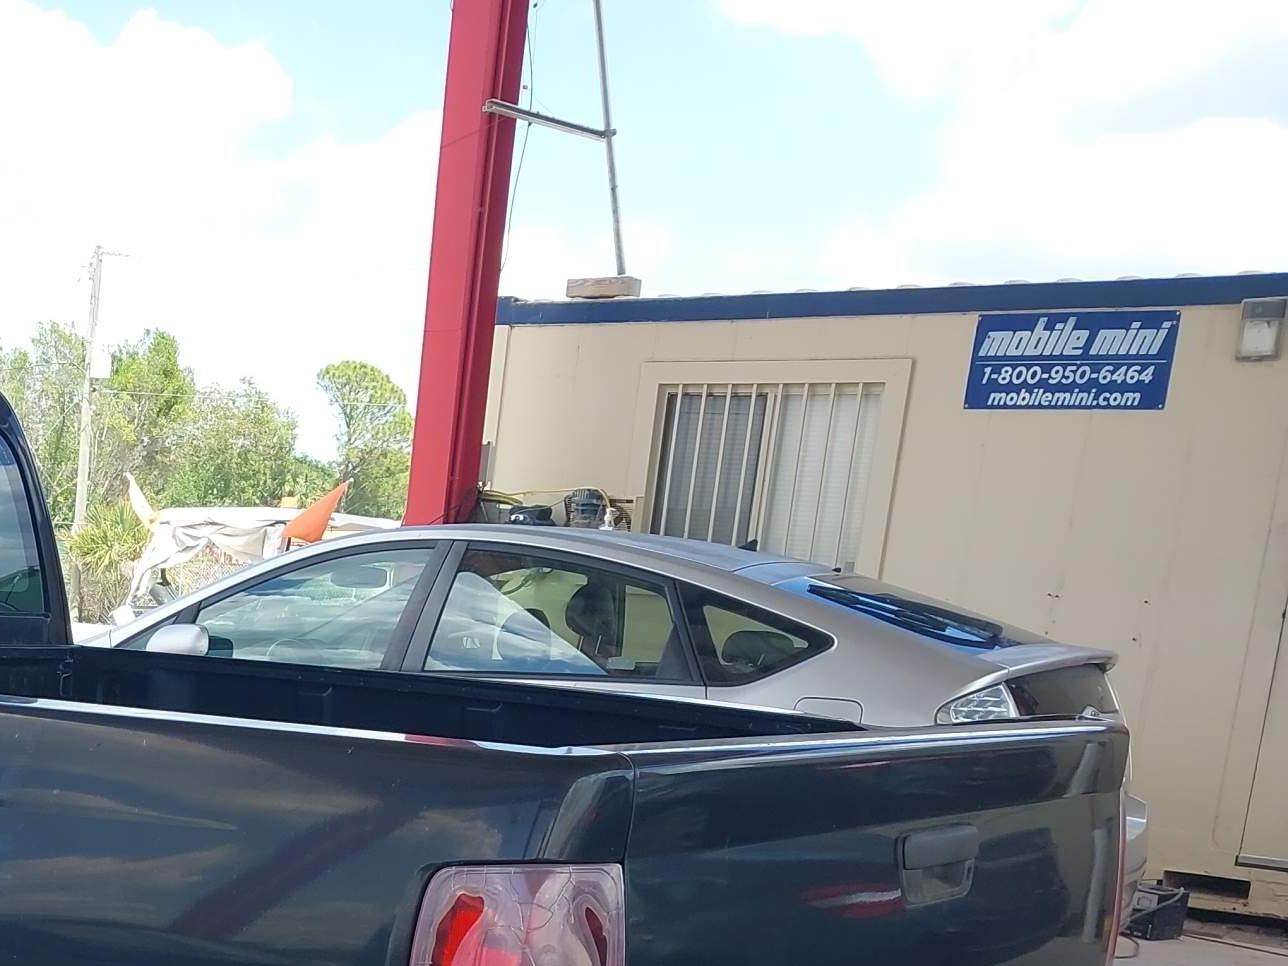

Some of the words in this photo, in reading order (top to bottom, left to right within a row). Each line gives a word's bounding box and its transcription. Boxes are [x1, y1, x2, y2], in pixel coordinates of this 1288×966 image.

[978, 317, 1090, 356] mobile
[1089, 321, 1172, 355] mini
[982, 365, 1156, 385] 1-800-950-6464
[987, 389, 1141, 407] mobilemini.com
